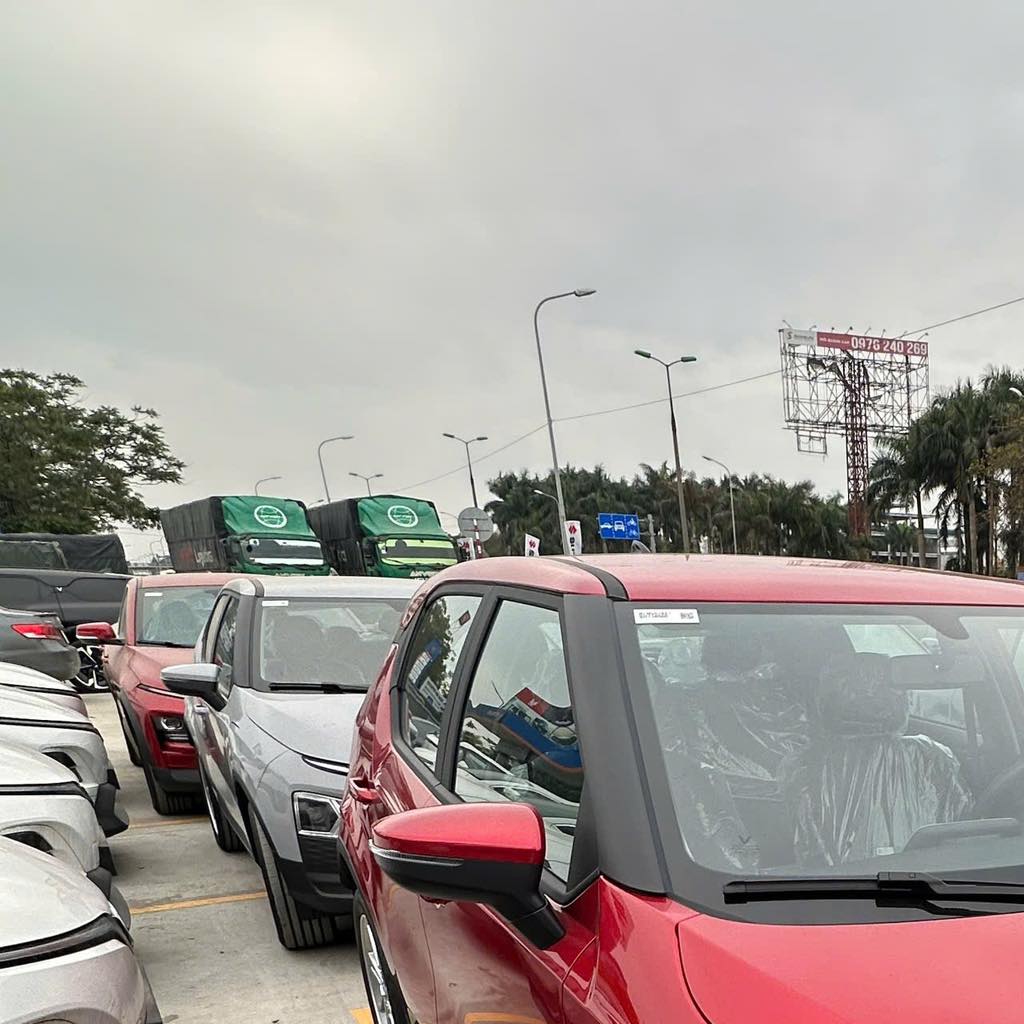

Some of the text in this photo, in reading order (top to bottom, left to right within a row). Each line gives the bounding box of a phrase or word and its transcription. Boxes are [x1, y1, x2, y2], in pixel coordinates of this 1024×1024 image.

[851, 336, 880, 352] 0976
[883, 339, 904, 353] 240
[907, 342, 927, 355] 269
